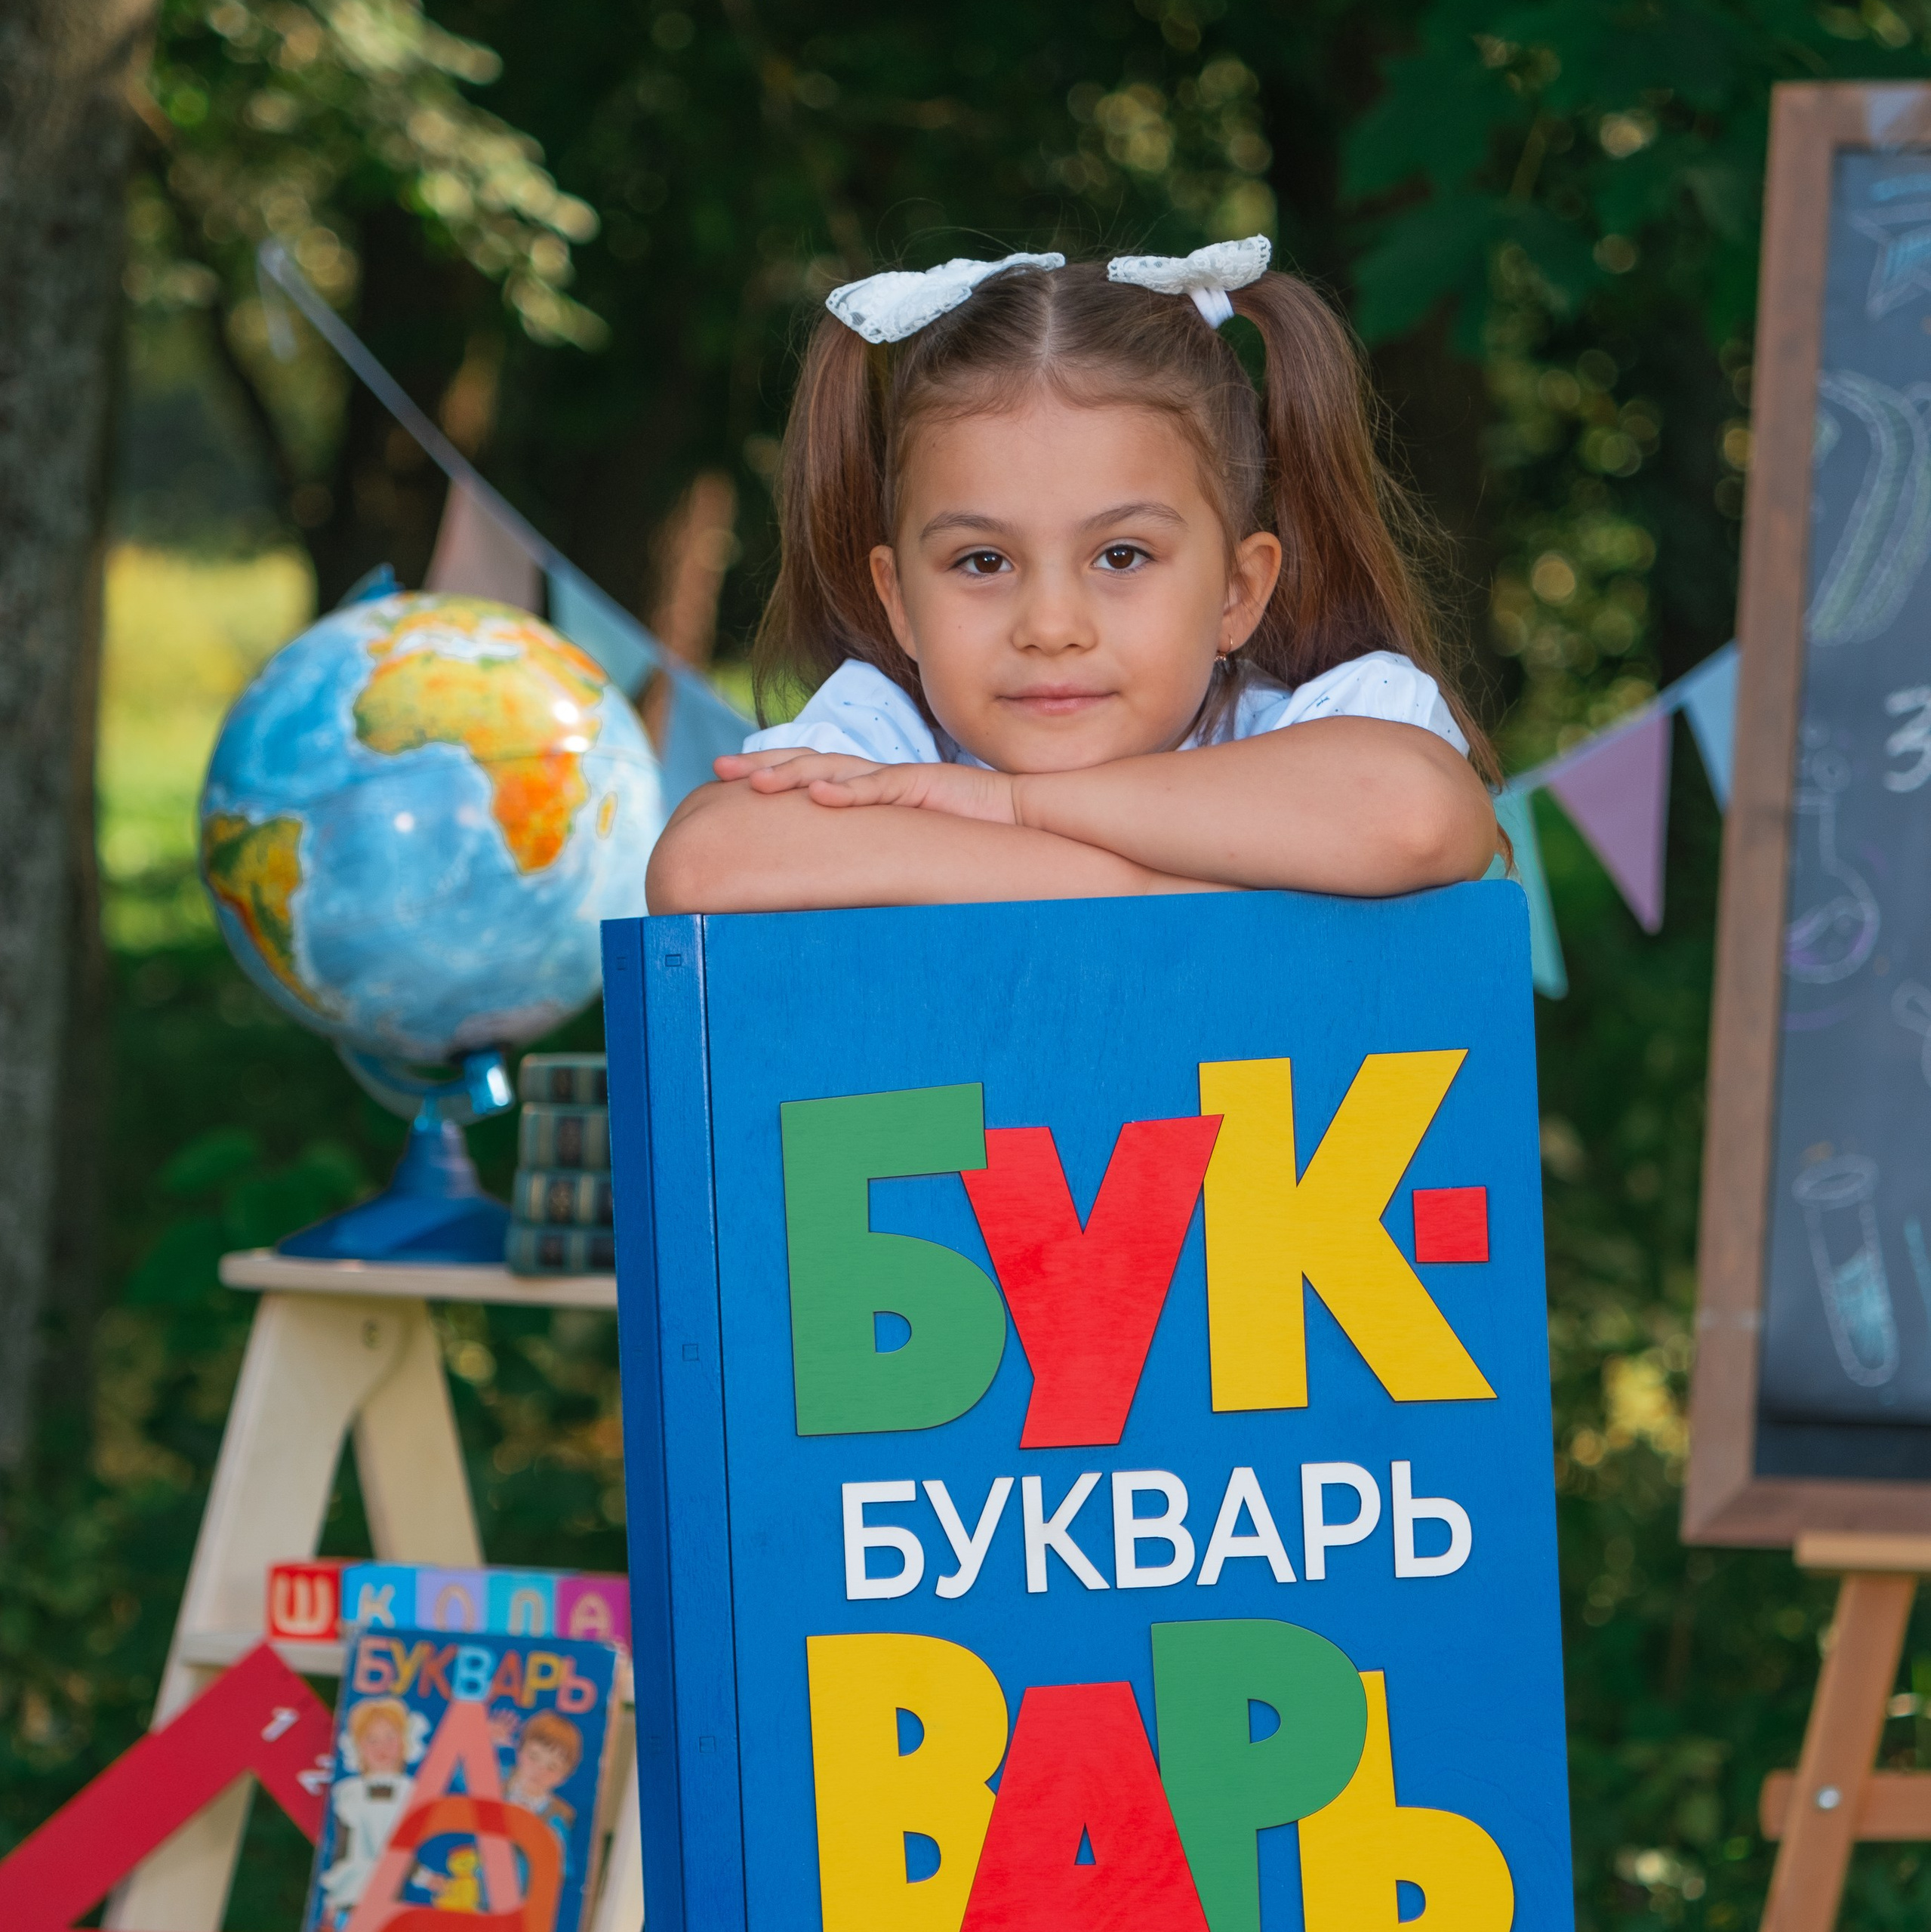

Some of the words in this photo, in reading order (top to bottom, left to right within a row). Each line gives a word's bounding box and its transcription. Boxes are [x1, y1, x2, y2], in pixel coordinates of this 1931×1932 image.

[781, 1048, 1498, 1450] БУК-
[842, 1460, 1473, 1601] БУКВАРЬ
[260, 1706, 300, 1742] 1
[353, 1635, 599, 1715] БУКВАРЬ
